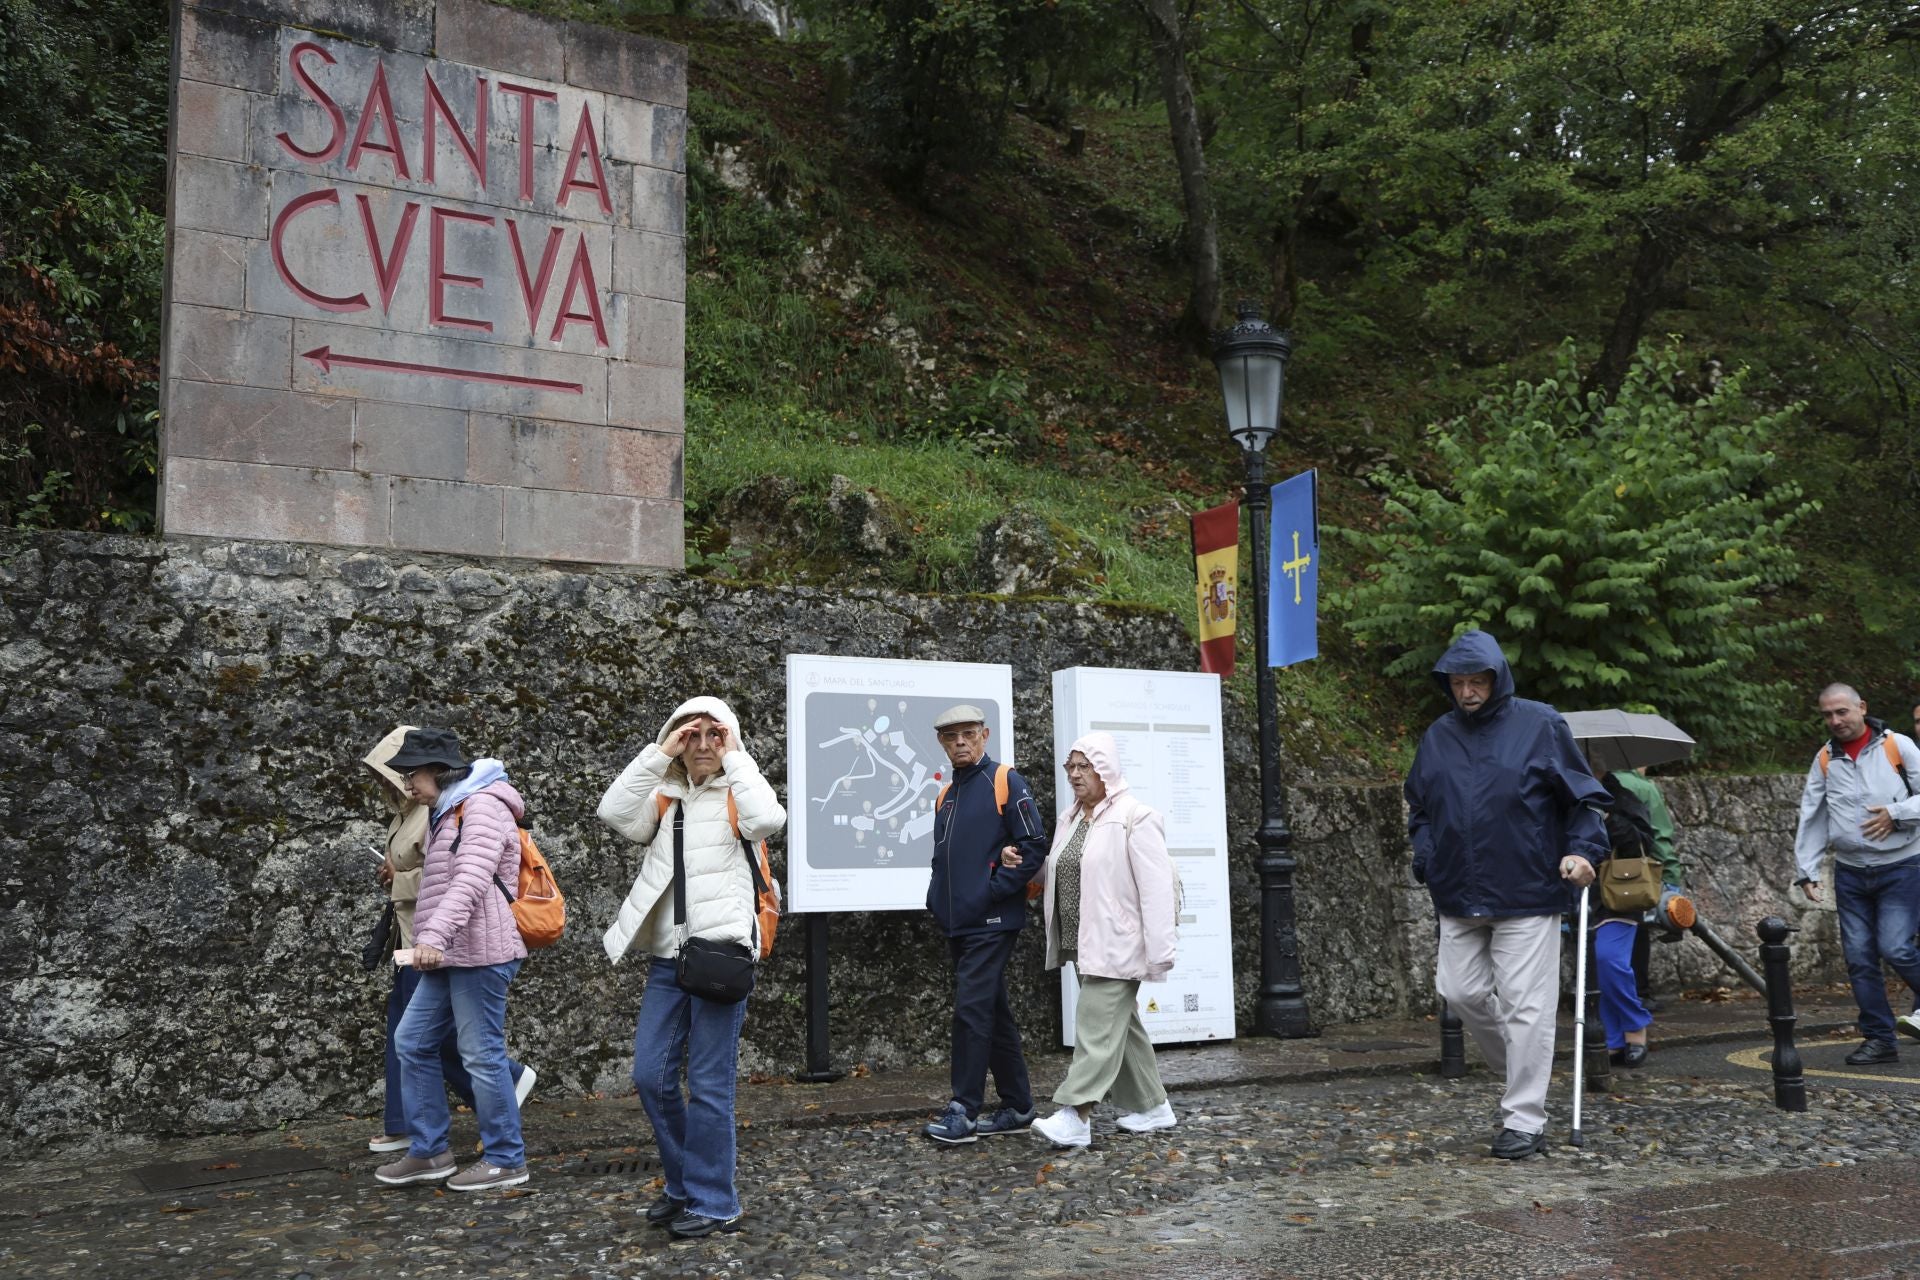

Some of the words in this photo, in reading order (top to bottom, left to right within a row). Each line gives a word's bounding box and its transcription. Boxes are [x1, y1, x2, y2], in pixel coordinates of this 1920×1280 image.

[275, 41, 613, 216] SANTA
[270, 187, 610, 349] CVEVA
[823, 676, 848, 686] MAPA
[849, 677, 865, 687] DEL
[867, 677, 916, 689] SANTUARIO
